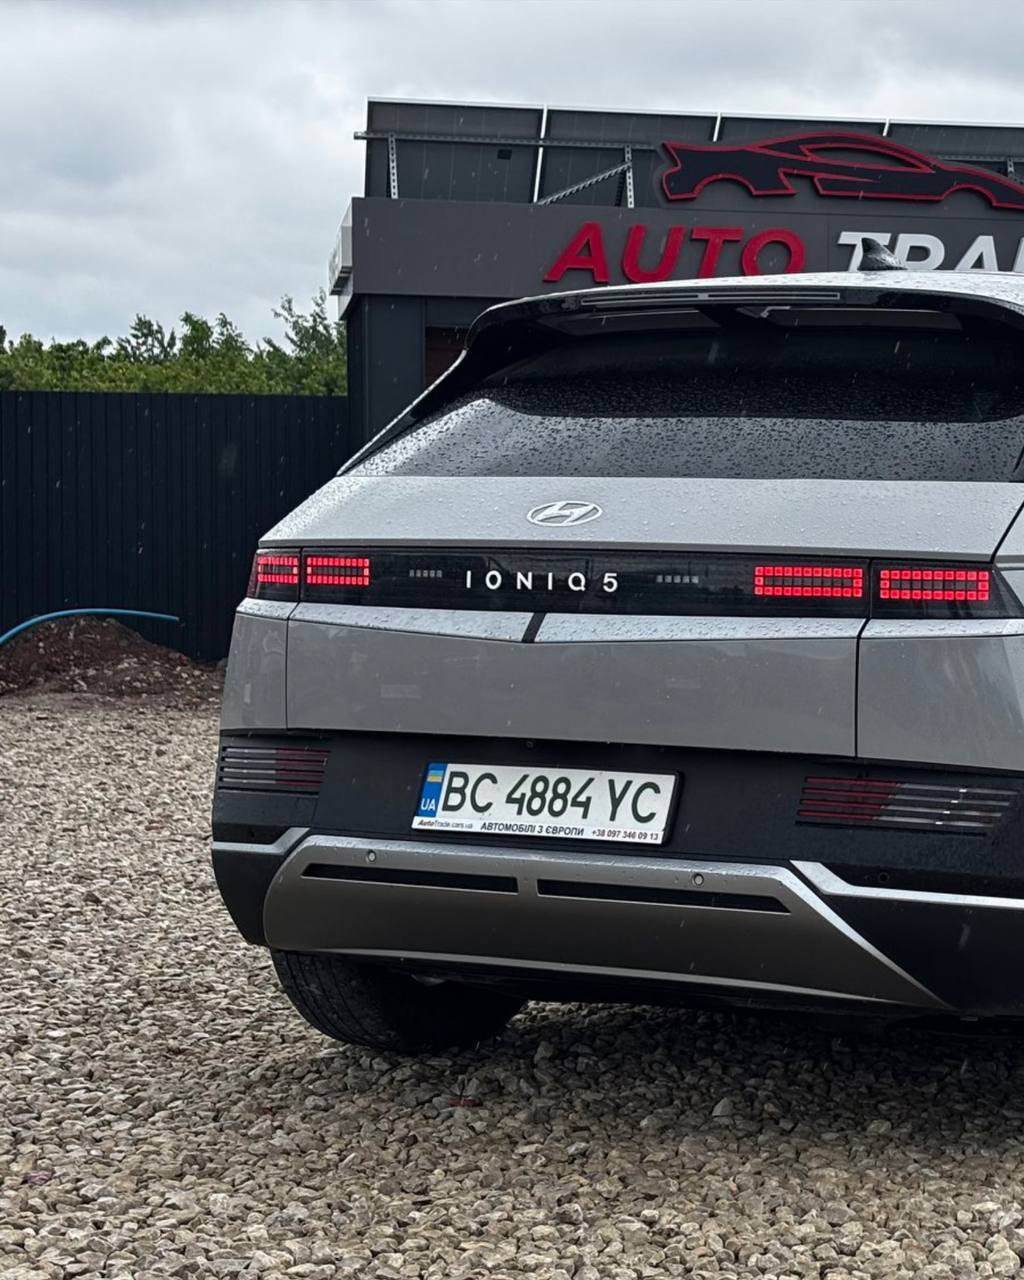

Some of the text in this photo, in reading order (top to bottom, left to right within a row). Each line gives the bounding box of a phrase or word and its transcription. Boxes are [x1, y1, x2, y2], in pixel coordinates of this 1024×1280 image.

[543, 222, 806, 283] AUTO
[466, 570, 618, 593] IONIQ 5
[420, 798, 436, 811] UA
[442, 771, 661, 824] BC 4884 YC
[480, 822, 536, 833] АВТОМОБІЛІ
[545, 825, 585, 836] ЄВРОПИ
[592, 829, 659, 840] +38 097 346 09 13
